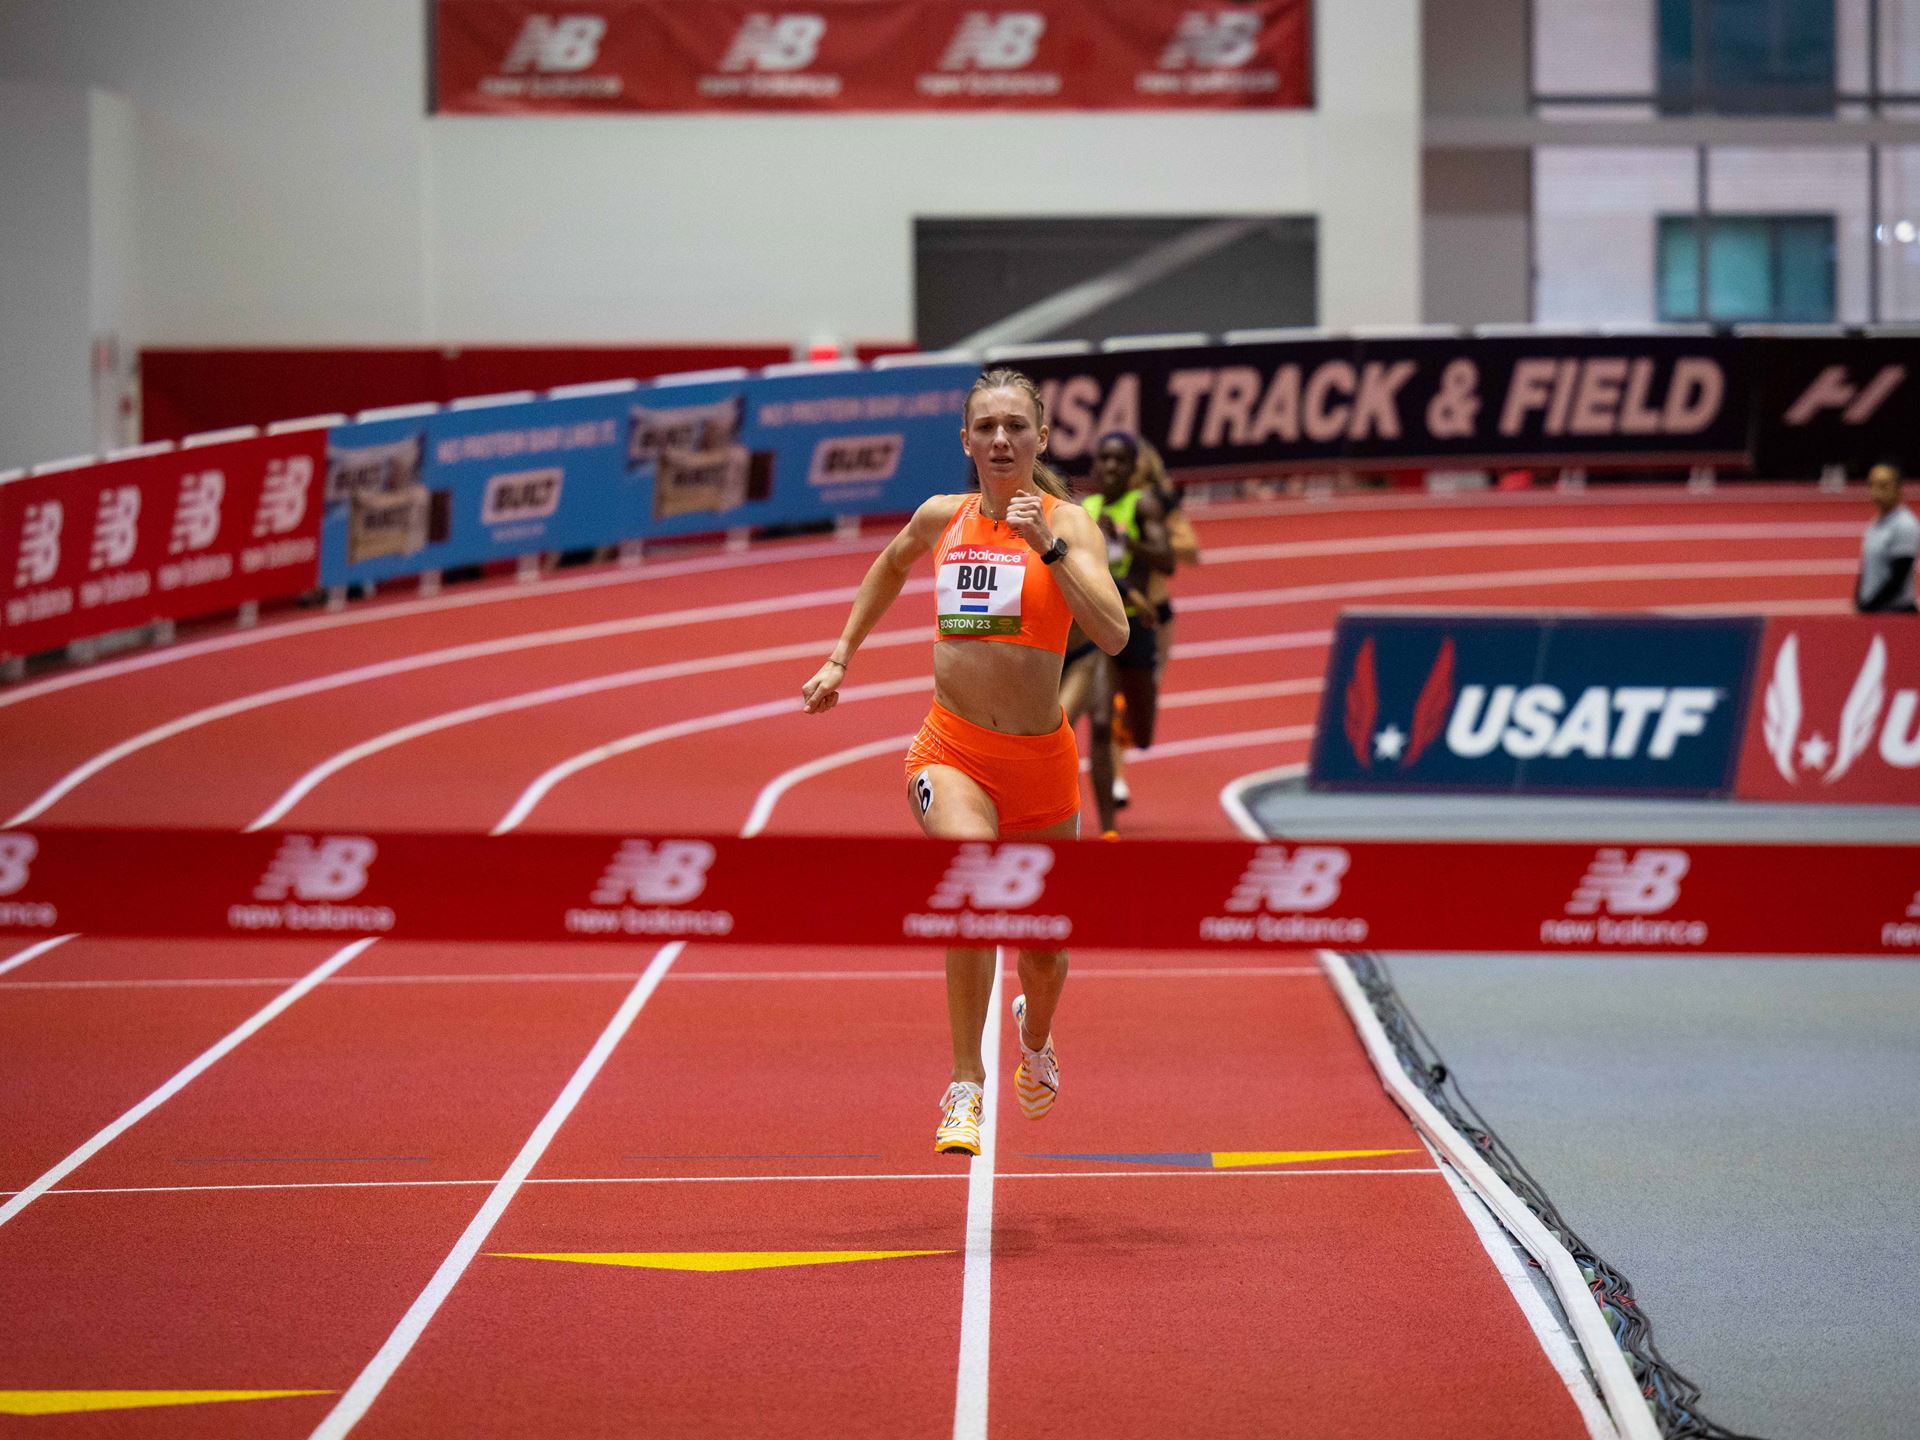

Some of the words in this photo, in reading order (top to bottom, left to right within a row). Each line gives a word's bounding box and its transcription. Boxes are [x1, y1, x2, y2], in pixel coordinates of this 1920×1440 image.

[503, 14, 607, 72] NB
[720, 13, 826, 72] NB
[940, 12, 1046, 71] NB
[1159, 10, 1262, 69] NB
[1167, 360, 1417, 451] TRACK
[1425, 357, 1481, 439] &
[1499, 356, 1725, 437] FIELD
[946, 550, 967, 561] new
[968, 549, 1022, 563] balance
[957, 565, 998, 591] BOL
[976, 620, 991, 629] 23
[1446, 685, 1721, 759] USATF
[253, 834, 377, 900] NB
[589, 839, 715, 903] NB
[928, 842, 1054, 909] NB
[1225, 845, 1351, 912] NB
[1564, 848, 1690, 914] NB
